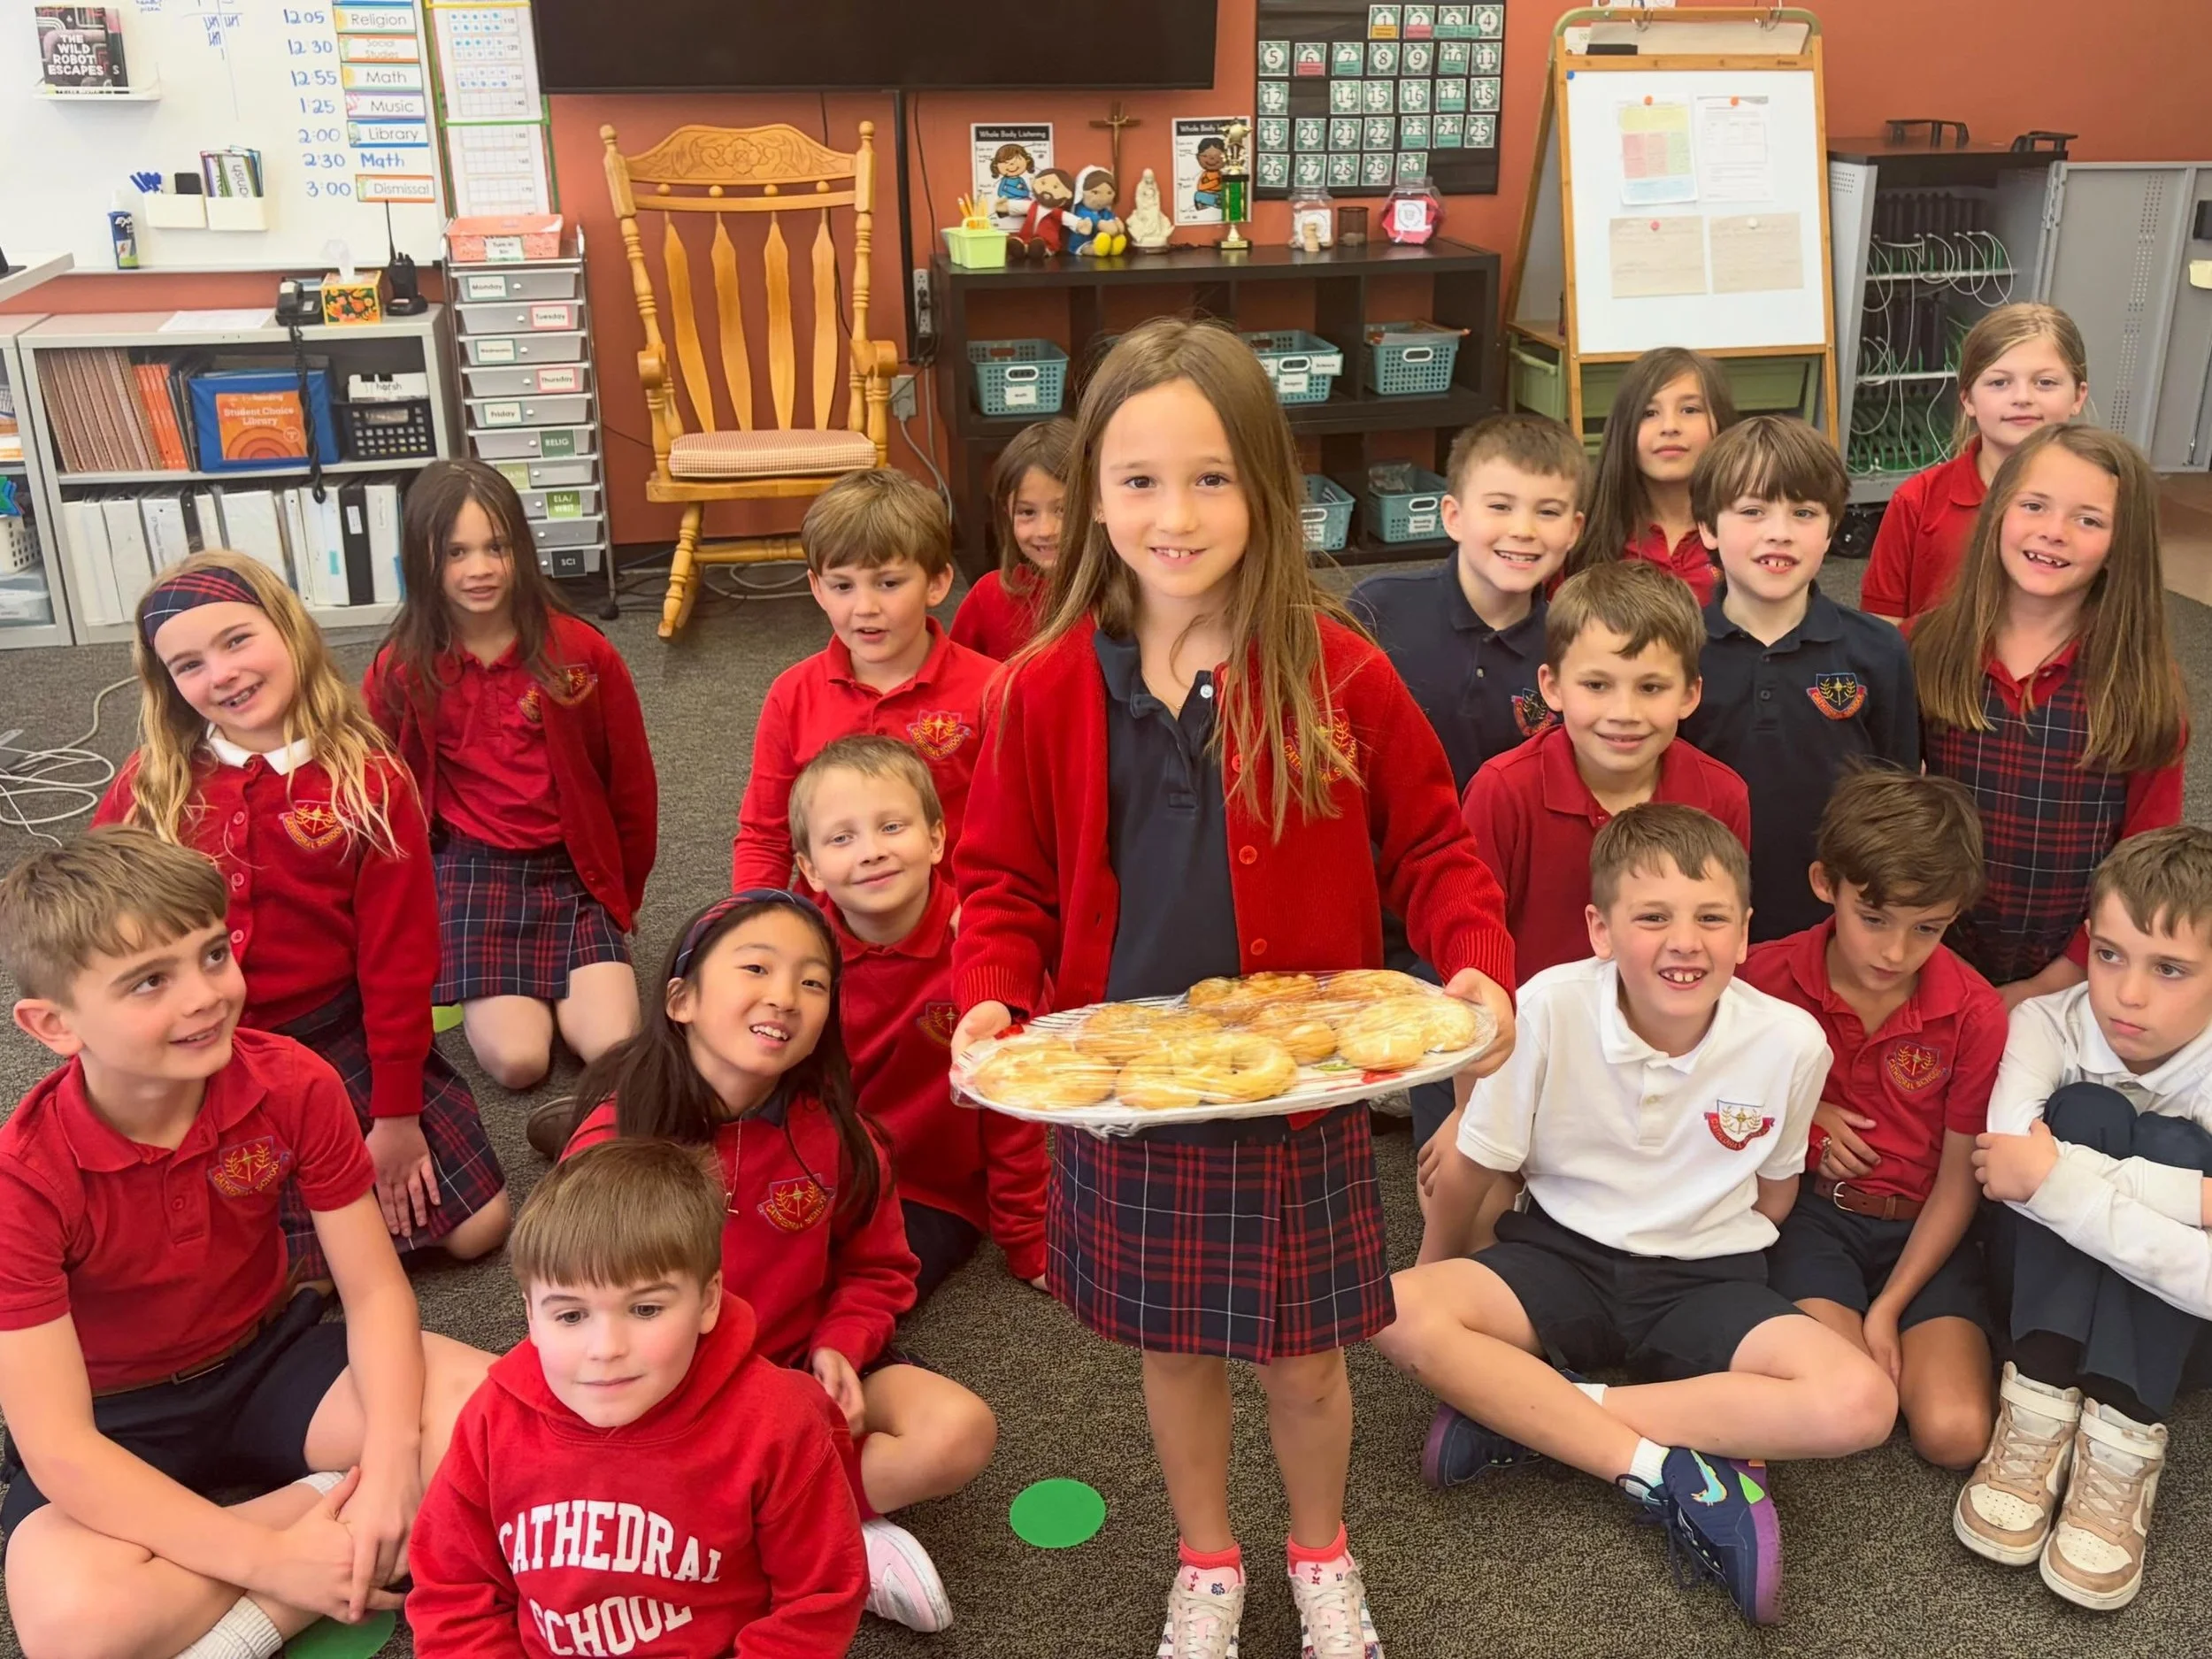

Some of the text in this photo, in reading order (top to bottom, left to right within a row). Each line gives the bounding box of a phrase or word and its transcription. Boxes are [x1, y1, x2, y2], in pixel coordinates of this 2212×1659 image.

[350, 13, 407, 28] Religion
[1382, 15, 1387, 25] 1
[1416, 15, 1423, 25] 2
[1449, 14, 1456, 25] 3
[1483, 14, 1492, 26] 4
[59, 34, 84, 43] THE
[365, 39, 396, 48] Social
[58, 43, 90, 54] WILD
[365, 50, 399, 59] Studies
[53, 53, 95, 65] ROBOT
[1269, 50, 1278, 64] 5
[1305, 51, 1314, 63] 6
[1344, 51, 1352, 62] 7
[1379, 51, 1387, 65] 8
[1413, 51, 1422, 65] 9
[1479, 51, 1494, 65] 11
[47, 65, 104, 76] ESCAPES
[291, 70, 337, 87] 12:55
[365, 71, 407, 84] Math
[1265, 91, 1282, 104] 12
[1338, 90, 1355, 103] 14
[1371, 89, 1386, 103] 15
[1408, 89, 1424, 102] 16
[1444, 88, 1458, 98] 17
[1477, 87, 1493, 100] 18
[300, 97, 335, 113] 1:25
[370, 100, 413, 112] Music
[297, 128, 340, 143] 2:00
[368, 127, 419, 142] Library
[1266, 127, 1281, 141] 19
[1302, 127, 1319, 141] 20
[1337, 127, 1352, 141] 21
[1370, 126, 1387, 139] 22
[1408, 126, 1424, 134] 23
[1440, 125, 1456, 134] 24
[1471, 125, 1487, 137] 25
[302, 153, 345, 168] 2:30
[360, 152, 404, 167] Math
[1263, 163, 1281, 176] 26
[1301, 163, 1318, 176] 27
[1335, 163, 1352, 175] 28
[1369, 162, 1386, 175] 29
[306, 180, 351, 197] 3:00
[373, 182, 429, 196] Dismissal
[472, 282, 503, 291] Monday
[541, 375, 573, 384] Thursday
[224, 408, 260, 417] Student
[490, 410, 516, 419] Friday
[242, 418, 278, 427] Library
[561, 557, 576, 566] SCI
[498, 1500, 722, 1584] CATHEDRAL
[529, 1595, 693, 1657] SCHOOL
